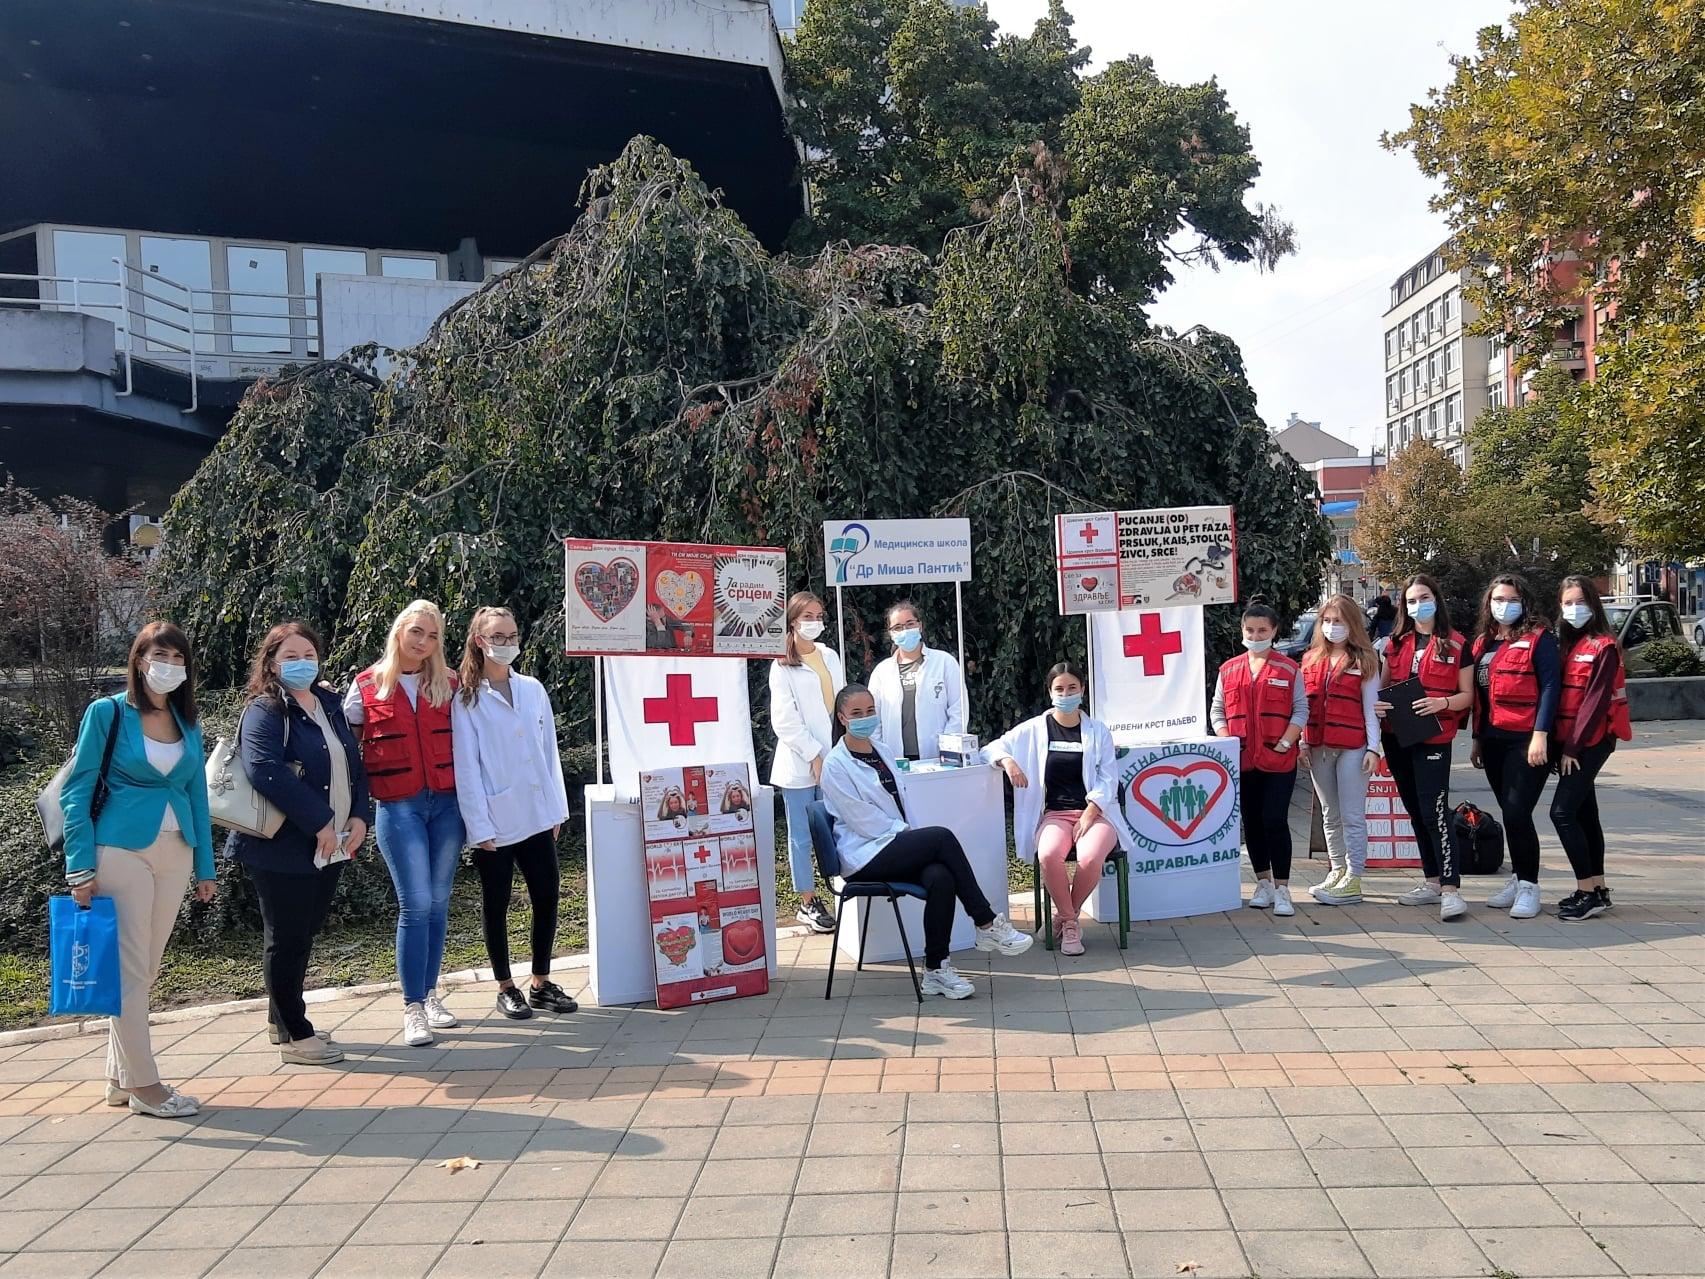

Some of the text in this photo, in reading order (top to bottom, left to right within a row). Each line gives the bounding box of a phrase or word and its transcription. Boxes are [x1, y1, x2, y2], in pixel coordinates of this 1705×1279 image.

[1119, 514, 1189, 525] PUCANJE (OD)
[1119, 522, 1232, 537] ZDRAVLJA U PET FAZA:
[874, 538, 968, 550] Медицинска школа
[1119, 538, 1162, 548] PRSLUK,
[1190, 533, 1233, 544] STOLICA,
[1151, 546, 1178, 557] SRCE!
[877, 563, 914, 576] Миша
[728, 589, 772, 602] срцем
[1073, 592, 1110, 603] ЗДРАВЉЕ
[1145, 720, 1165, 729] КРСТ
[1166, 715, 1197, 727] ВАЉЕВО
[1368, 783, 1392, 793] ŠNJI
[1135, 853, 1209, 874] ЗДРАВЉА
[1212, 848, 1240, 863] ВАЉ
